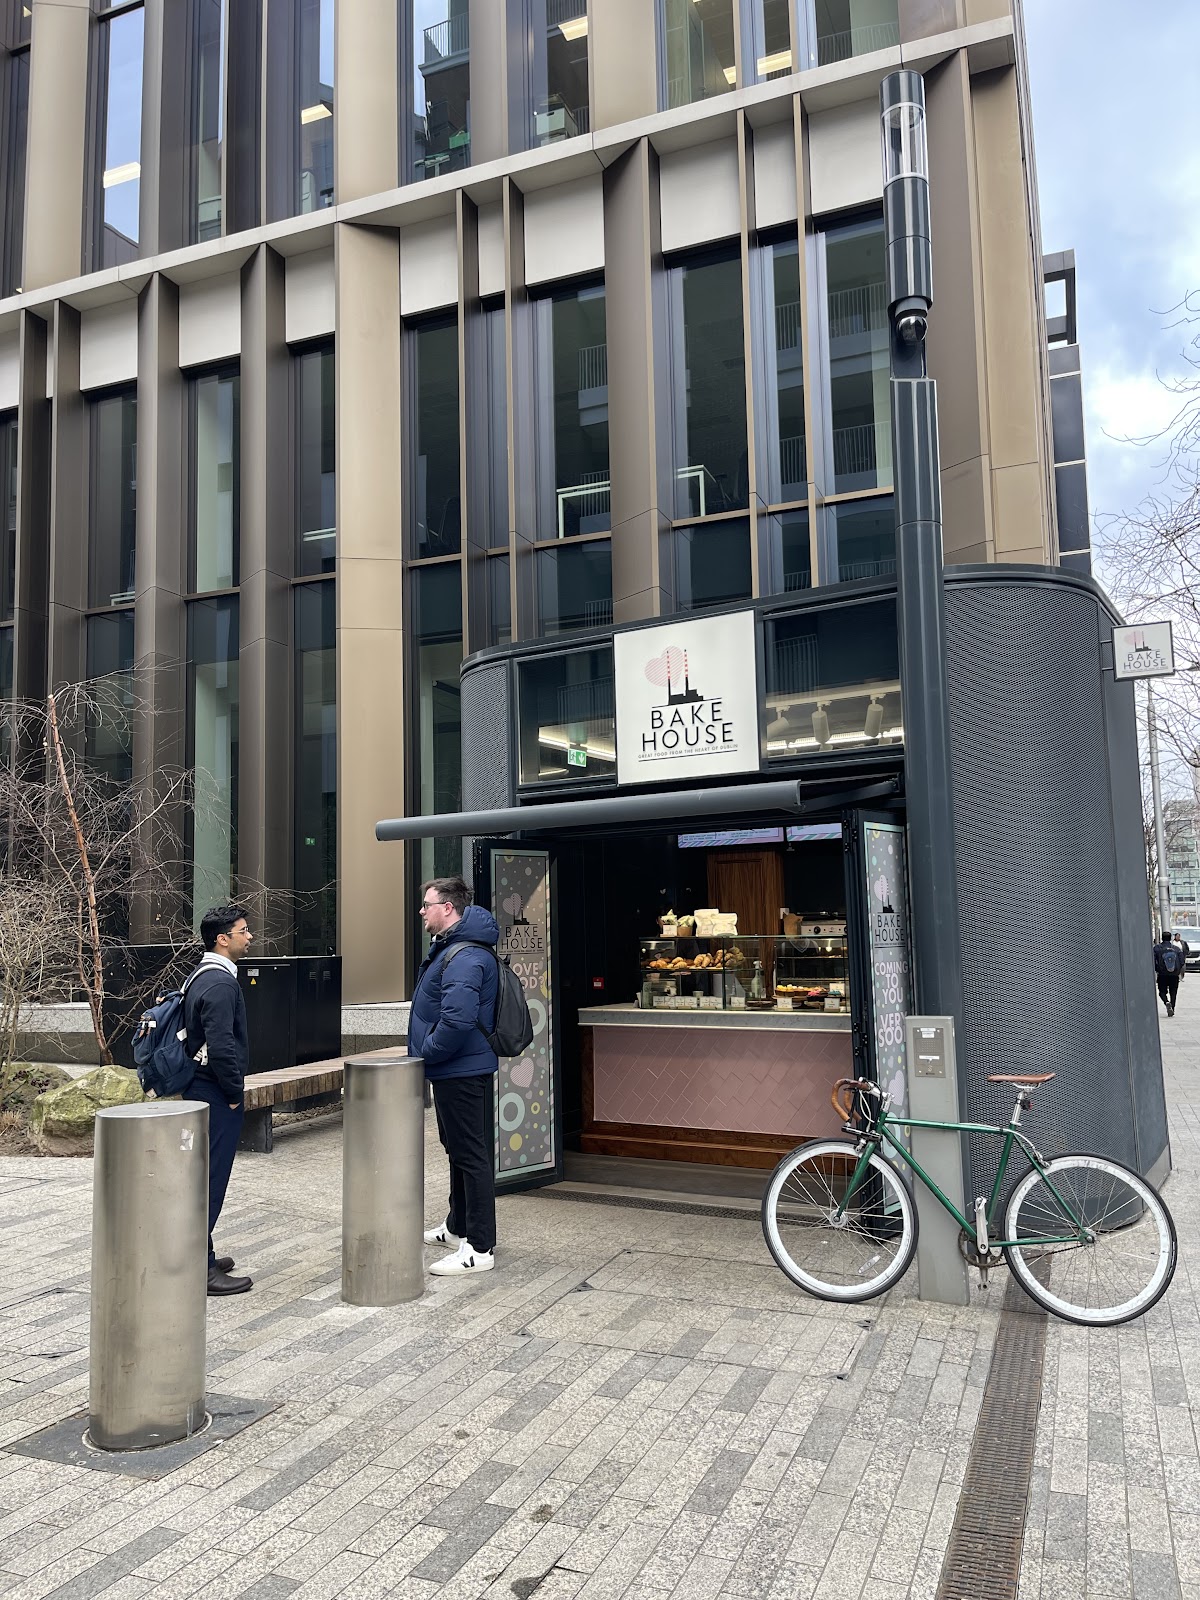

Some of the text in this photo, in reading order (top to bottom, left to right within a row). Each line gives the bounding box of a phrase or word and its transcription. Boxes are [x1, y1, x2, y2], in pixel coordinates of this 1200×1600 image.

[1128, 651, 1161, 661] BAKE
[1124, 658, 1166, 670] HOUSE
[651, 701, 722, 729] BAKE
[642, 722, 733, 752] HOUSE
[877, 914, 901, 928] BAKE
[505, 926, 538, 938] BAKE
[874, 928, 905, 942] HOUSE
[501, 937, 543, 950] HOUSE
[512, 962, 539, 977] OVE
[874, 961, 909, 976] COMING
[520, 975, 545, 989] OD?
[885, 973, 899, 989] TO
[882, 986, 904, 1005] YOU
[878, 1024, 906, 1048] SOO
